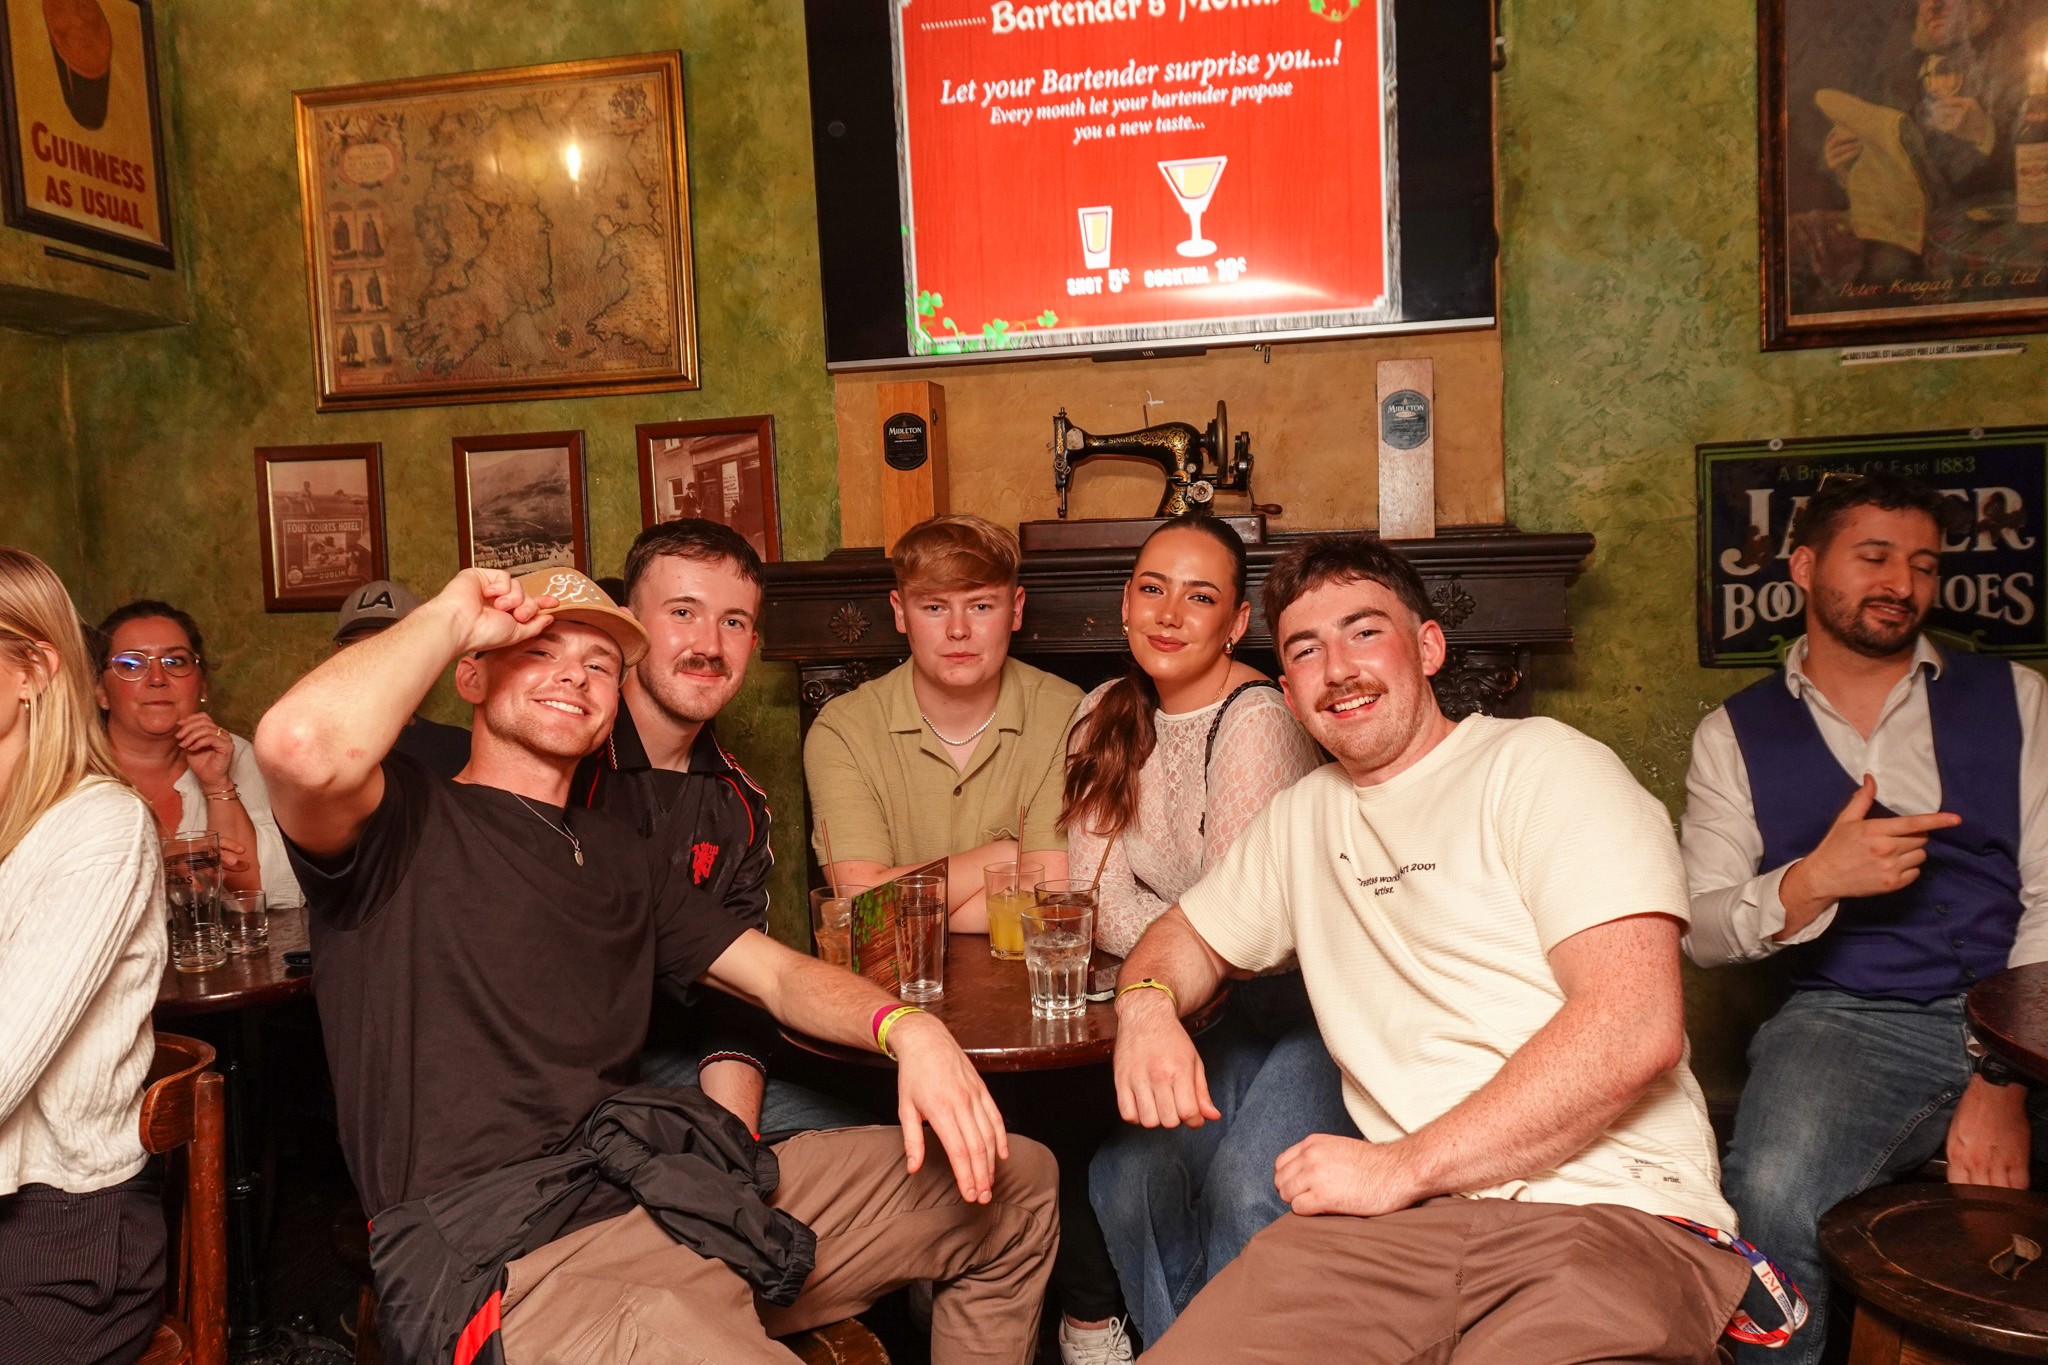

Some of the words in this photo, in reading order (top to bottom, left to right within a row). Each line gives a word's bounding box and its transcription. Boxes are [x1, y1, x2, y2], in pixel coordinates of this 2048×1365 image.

[940, 79, 977, 105] Let
[981, 76, 1036, 108] your
[1040, 59, 1159, 95] Bartender
[1164, 51, 1261, 86] surprise
[1263, 38, 1342, 80] you...!
[990, 105, 1034, 127] Every
[1036, 97, 1086, 120] month
[1089, 95, 1109, 116] let
[1110, 95, 1150, 118] your
[1151, 84, 1229, 110] bartender
[1230, 81, 1294, 107] propose
[1072, 126, 1103, 146] you
[1105, 123, 1116, 138] a
[1119, 120, 1153, 136] new
[1155, 114, 1206, 133] taste...
[31, 121, 146, 193] GUINNESS
[45, 175, 73, 208] AS
[81, 186, 144, 230] USUAL
[1066, 275, 1103, 296] SHOT
[1839, 283, 1881, 297] Peter
[1888, 276, 1954, 300] Keegan
[1961, 273, 1974, 288] &
[1387, 404, 1425, 414] MIDLETON
[888, 427, 922, 436] MIDLETON
[1779, 466, 1791, 481] A
[1934, 456, 1977, 474] 1883
[287, 522, 308, 534] FOUR
[309, 521, 336, 533] COURTS
[338, 521, 360, 531] HOTEL
[319, 570, 346, 580] DUBLIN
[356, 590, 396, 612] LA
[1410, 862, 1437, 872] 2001
